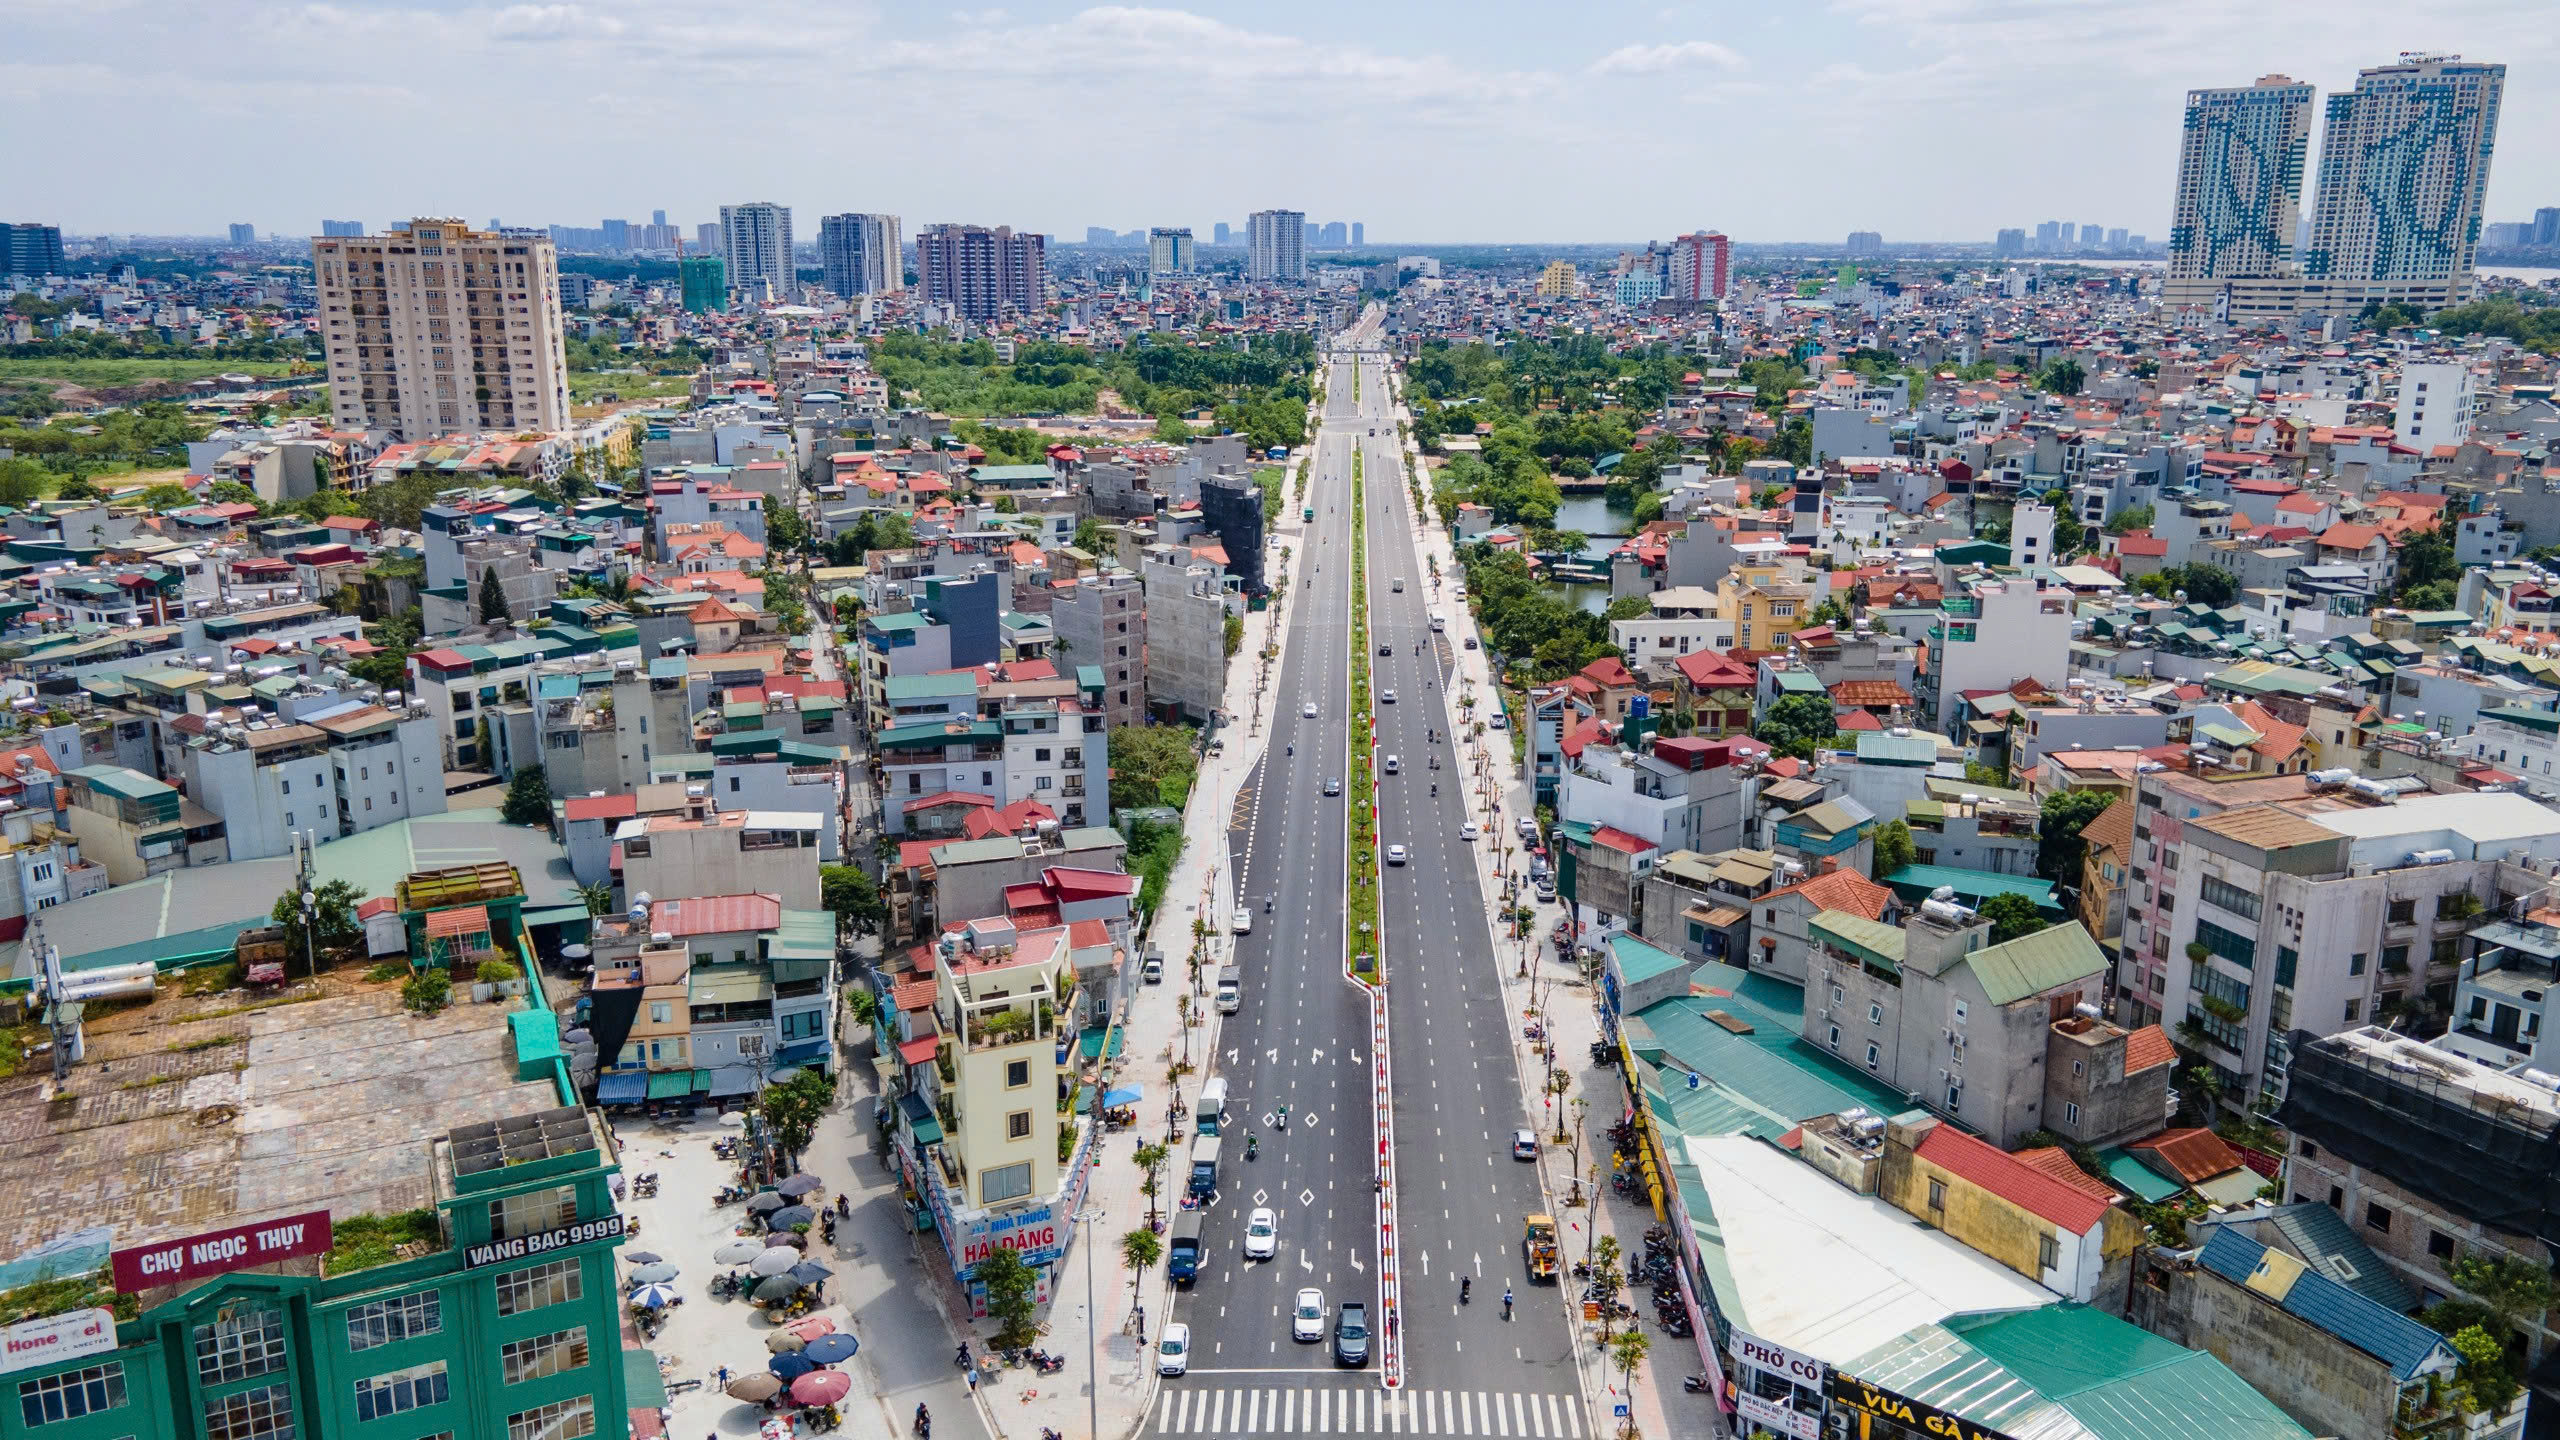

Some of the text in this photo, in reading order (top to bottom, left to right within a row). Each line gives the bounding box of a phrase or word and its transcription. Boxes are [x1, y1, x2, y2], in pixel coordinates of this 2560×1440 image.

[140, 1223, 304, 1273] CHỢ NGỌC THỤY
[470, 1217, 621, 1265] VÀNG BẠC 9999
[964, 1235, 996, 1263] HẢI
[1743, 1341, 1785, 1368] PHỞ
[1863, 1390, 1916, 1424] VUA
[1925, 1415, 1963, 1440] GÀ
